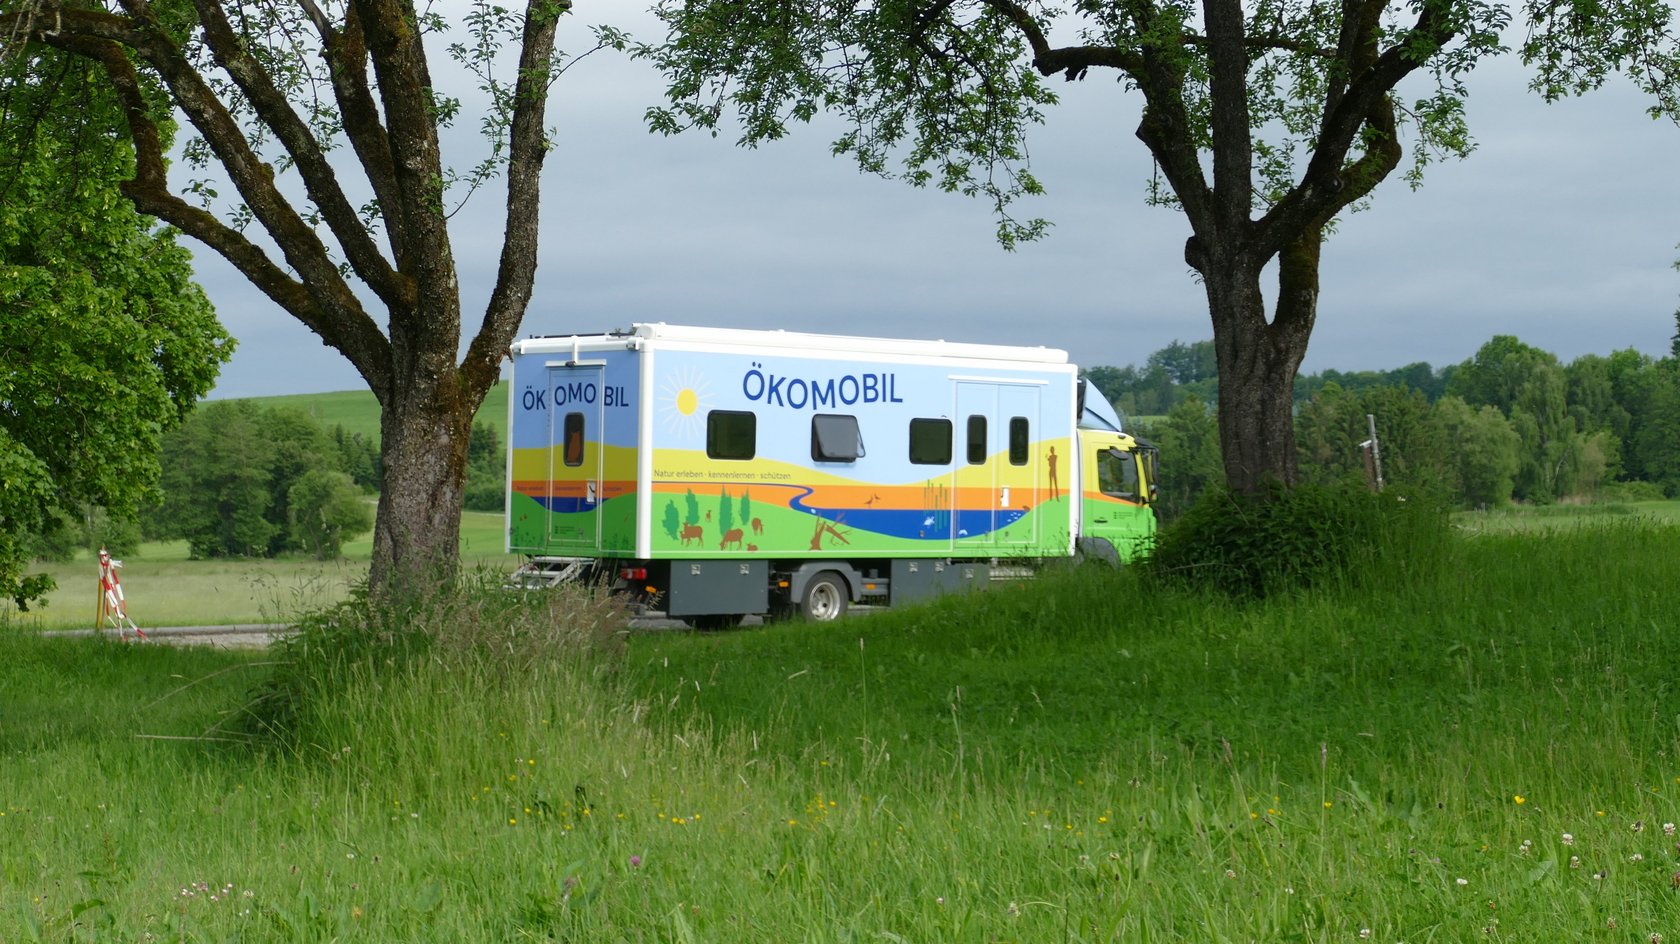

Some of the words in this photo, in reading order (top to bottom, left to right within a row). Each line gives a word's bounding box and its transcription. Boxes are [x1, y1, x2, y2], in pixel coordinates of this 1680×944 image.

[743, 361, 903, 410] ÖKOMOBIL
[654, 469, 674, 477] Natur
[675, 470, 703, 478] erleben
[708, 471, 755, 479] kennenlernen
[760, 472, 791, 480] schützen
